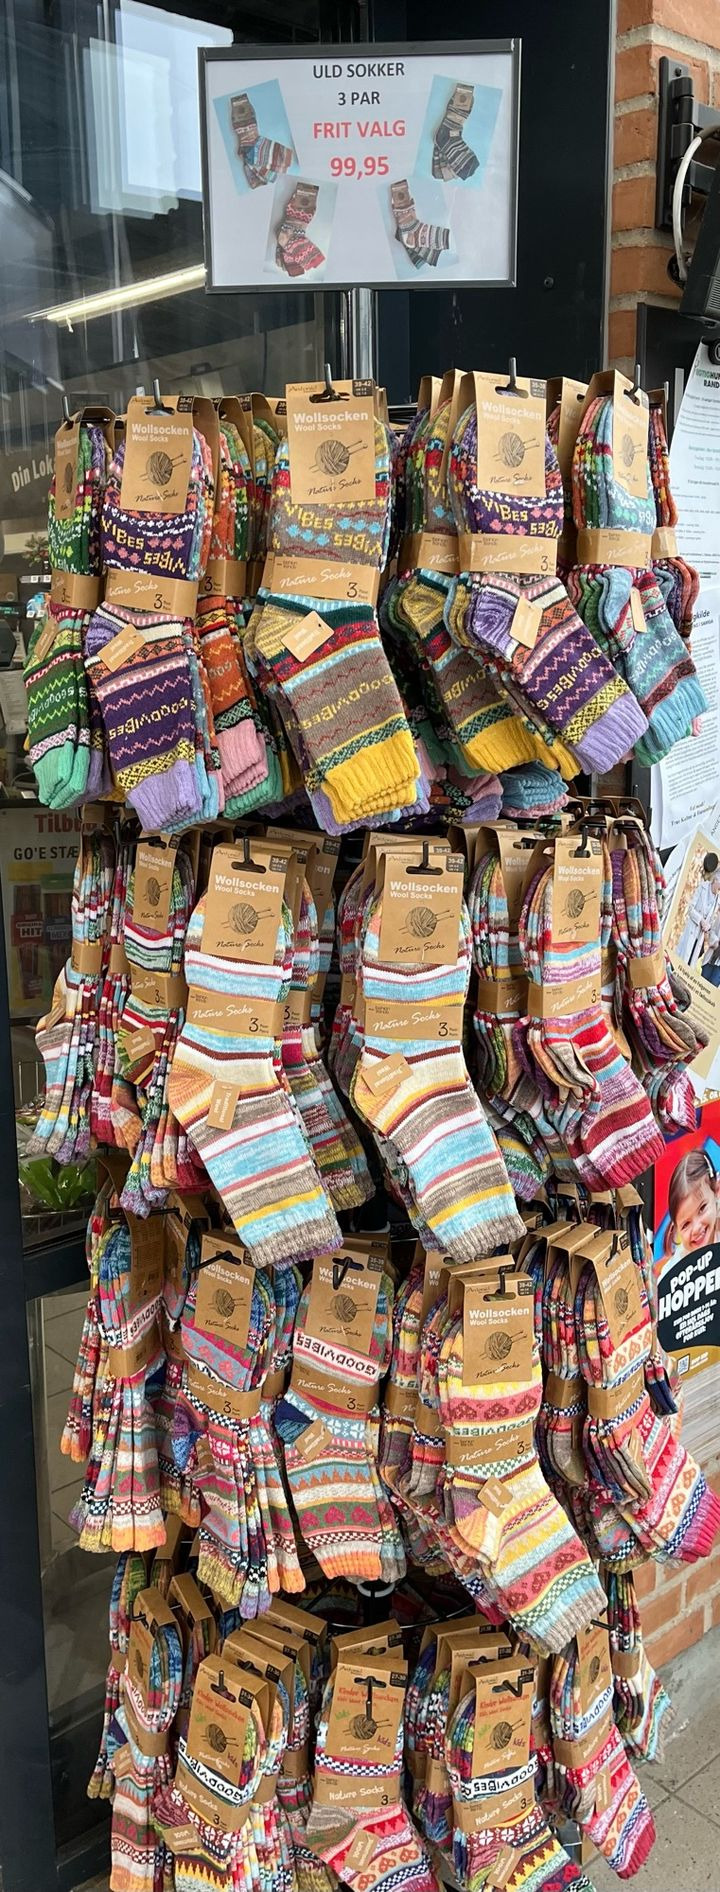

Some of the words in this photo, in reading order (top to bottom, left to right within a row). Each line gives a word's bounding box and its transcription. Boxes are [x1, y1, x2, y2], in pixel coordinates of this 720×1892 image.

[313, 64, 342, 79] ULD
[346, 62, 405, 78] SOKKER
[338, 92, 346, 106] 3
[351, 91, 381, 105] PAR
[313, 122, 352, 139] FRIT
[358, 120, 406, 138] VALG
[330, 156, 389, 180] 99,95
[481, 400, 542, 419] Wollsocken
[292, 410, 368, 424] Wollsocken
[132, 424, 189, 436] Wollsocken
[294, 423, 316, 432] Wool
[317, 422, 342, 432] Socks
[132, 434, 148, 442] Wool
[150, 434, 168, 443] Socks
[11, 464, 31, 493] Din
[338, 478, 362, 490] Socks
[284, 501, 334, 529] VIBES
[482, 496, 528, 522] VIBES
[102, 517, 145, 550] VIBES
[520, 543, 544, 557] Socks
[540, 556, 549, 572] 3
[204, 576, 212, 591] 3
[280, 575, 318, 589] Nature
[320, 568, 352, 582] Socks
[134, 581, 159, 594] Socks
[346, 582, 358, 598] 3
[153, 594, 163, 610] 3
[548, 647, 602, 702] OODVIBES
[14, 847, 46, 860] GO'E
[138, 851, 172, 868] Wollsocken
[558, 866, 600, 876] Wollsocken
[214, 874, 280, 894] Wollsocken
[214, 884, 234, 893] Wool
[234, 886, 256, 897] Socks
[390, 881, 458, 894] Wollsocken
[410, 892, 432, 900] Socks
[21, 928, 42, 936] HIT
[216, 940, 242, 948] Nature
[394, 944, 422, 954] Nature
[422, 942, 445, 952] Socks
[154, 989, 160, 1003] 3
[591, 988, 597, 1004] 3
[192, 1009, 224, 1019] Nature
[226, 1004, 254, 1017] Socks
[284, 1006, 290, 1020] 3
[248, 1017, 259, 1032] 3
[372, 1019, 409, 1032] Nature
[412, 1010, 441, 1025] Socks
[438, 1022, 448, 1037] 3
[319, 1266, 376, 1290] Woocken
[670, 1250, 713, 1294] POP-UP
[319, 1275, 333, 1284] Woo
[469, 1307, 530, 1320] Wollsocken
[470, 1318, 488, 1326] Wool
[343, 1327, 362, 1337] Socks
[206, 1385, 227, 1398] Socks
[296, 1379, 324, 1391] Nature
[326, 1383, 352, 1395] Socks
[223, 1401, 232, 1414] 3
[346, 1398, 356, 1411] 3
[459, 1448, 492, 1462] Nature
[494, 1434, 519, 1451] Socks
[516, 1440, 525, 1454] 3
[329, 1789, 357, 1801] Nature
[360, 1786, 385, 1797] Socks
[380, 1794, 389, 1806] 3
[475, 1808, 500, 1826] Nature
[502, 1791, 523, 1808] Socks
[520, 1798, 527, 1810] 3
[213, 1814, 220, 1825] 3
